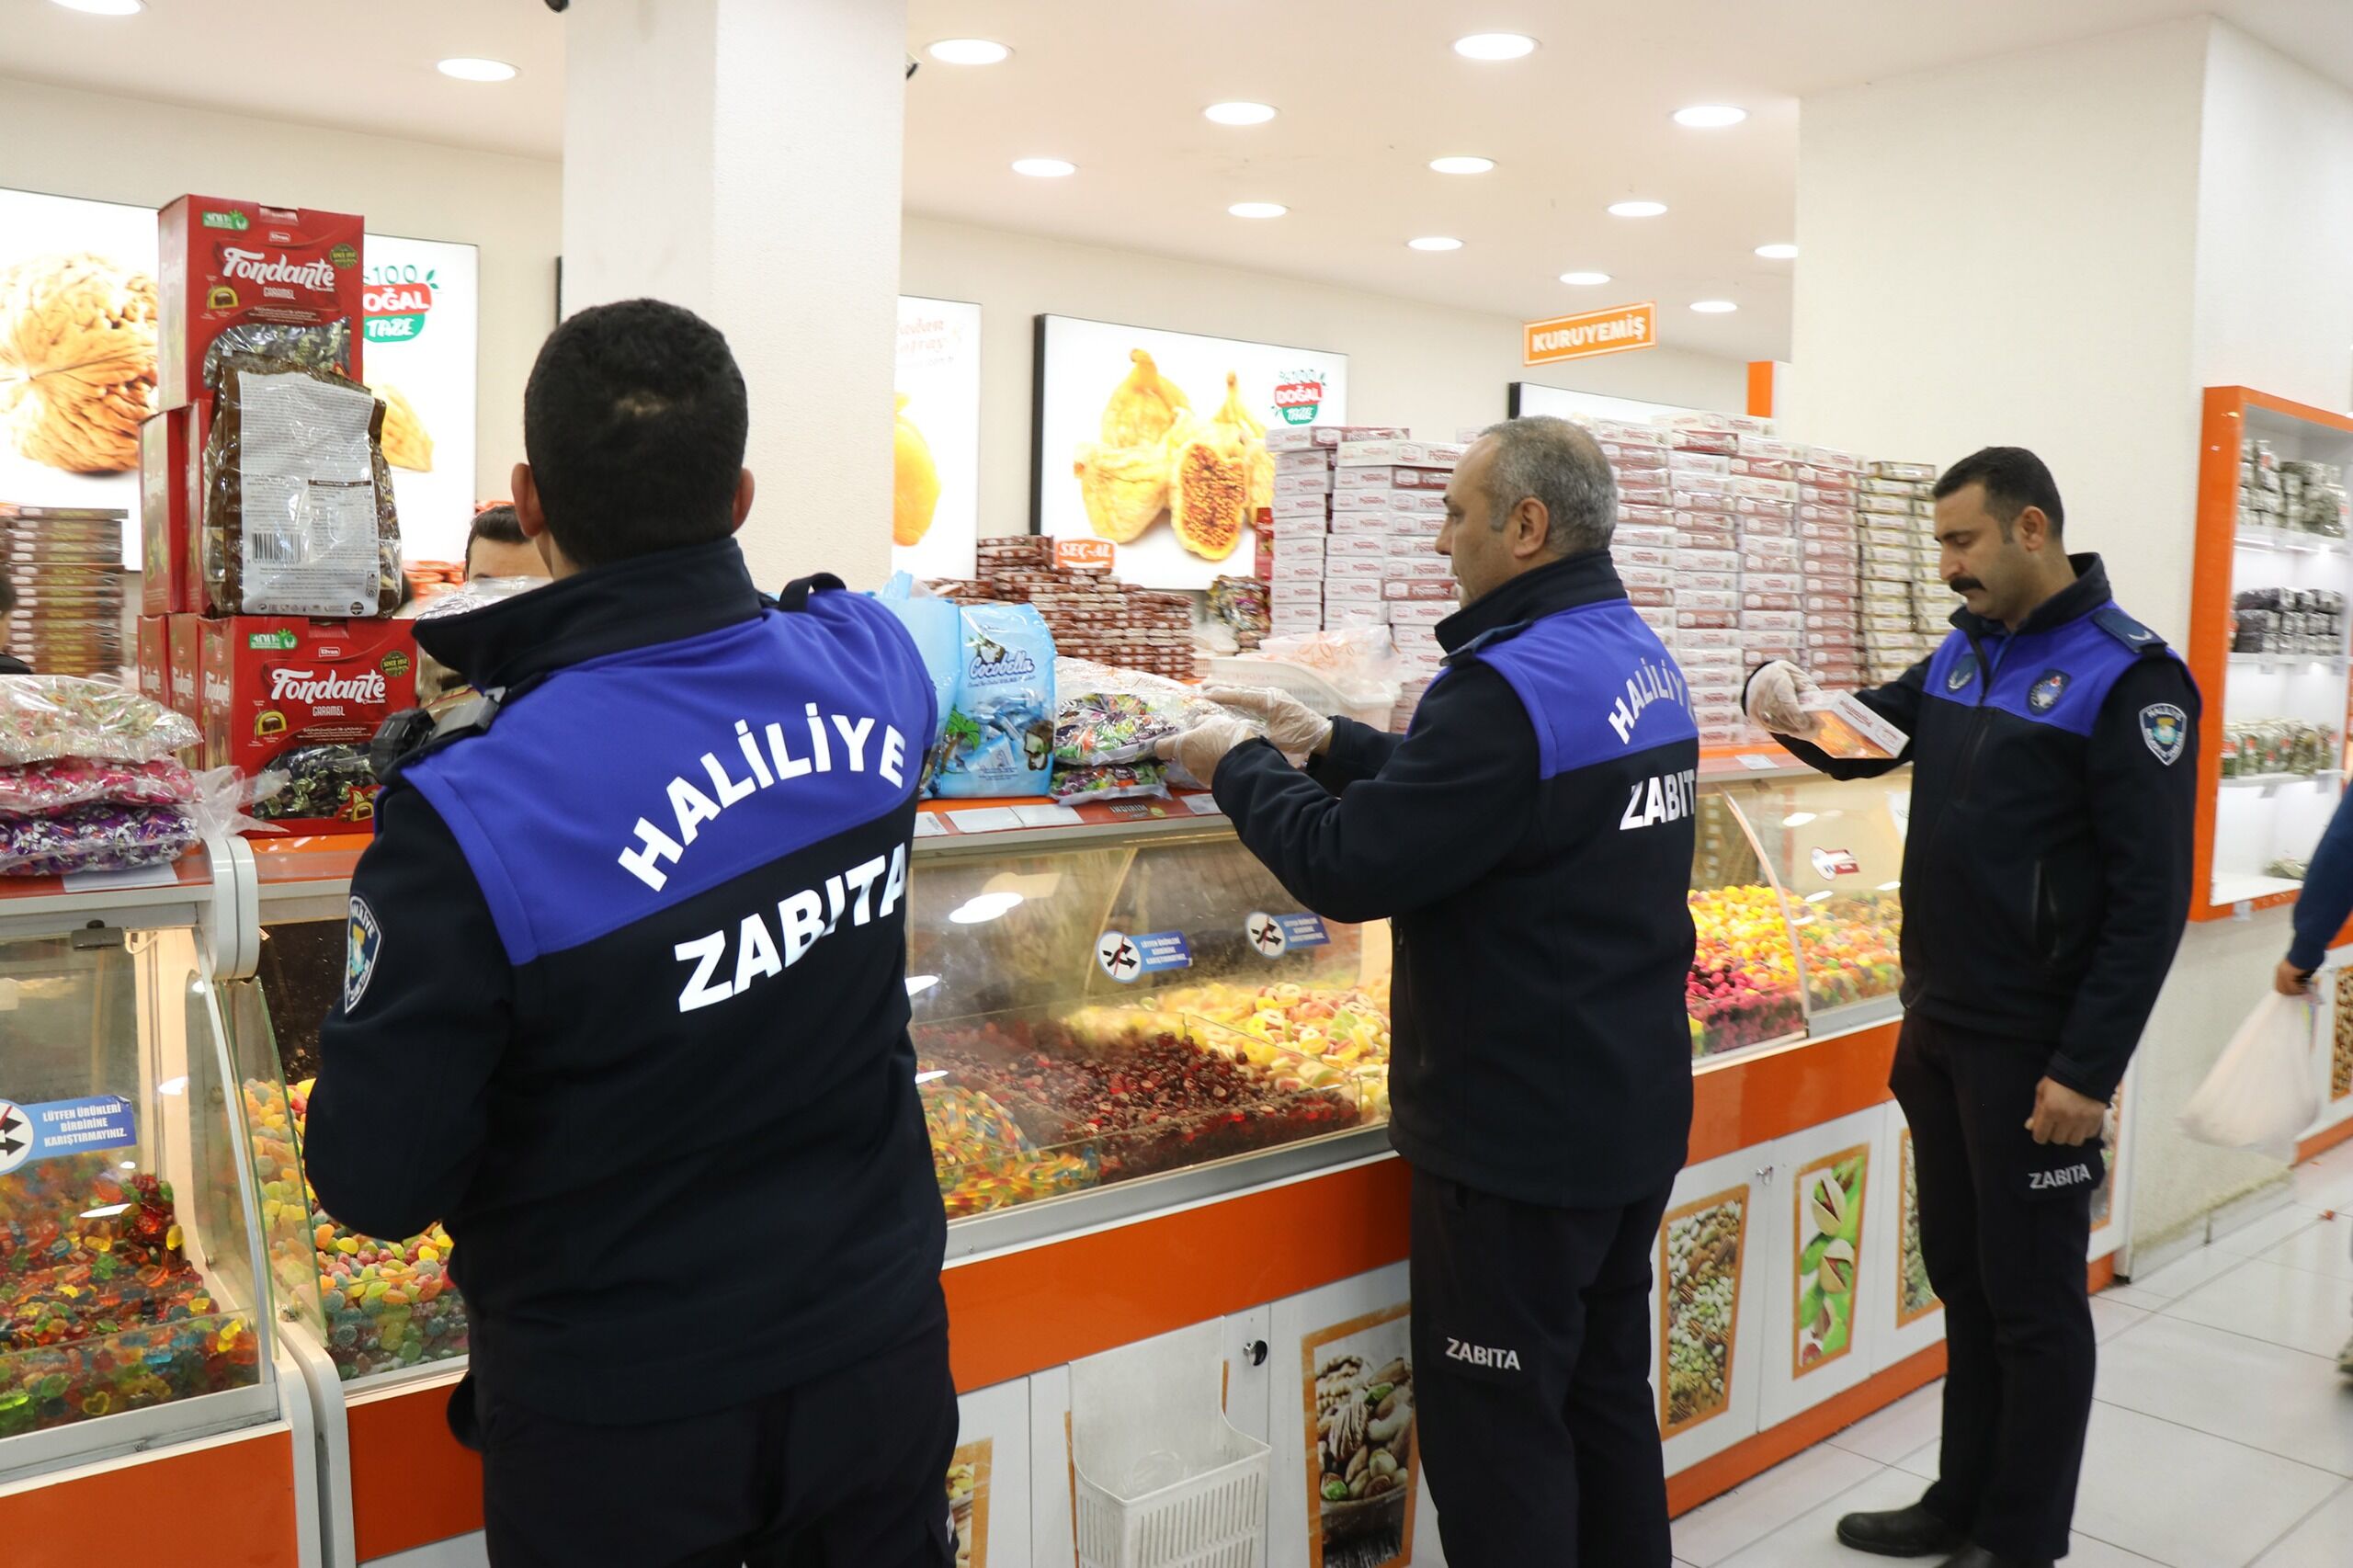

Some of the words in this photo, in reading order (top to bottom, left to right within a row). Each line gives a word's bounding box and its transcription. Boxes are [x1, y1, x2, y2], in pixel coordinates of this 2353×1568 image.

[222, 246, 335, 290] Fondanté
[362, 287, 431, 312] OĞAL
[366, 317, 415, 338] TAZE
[1532, 313, 1647, 353] KURUYEMİŞ
[1275, 385, 1322, 404] DOĞAL
[969, 649, 1035, 680] Cocobella
[271, 668, 386, 704] Fondanté
[313, 706, 346, 717] CARAMEL
[618, 702, 905, 892] HALİLİYE
[1620, 769, 1695, 831] ZABIT
[675, 843, 906, 1012] ZABITA
[42, 1108, 76, 1122] LÜTFEN
[76, 1102, 122, 1118] ÜRÜNLERİ
[60, 1118, 108, 1132] BİRBİRİNE
[43, 1128, 128, 1147] KARIŞTIRMAYINIZ.
[2028, 1163, 2092, 1189] ZABITA
[1445, 1336, 1521, 1370] ZABITA
